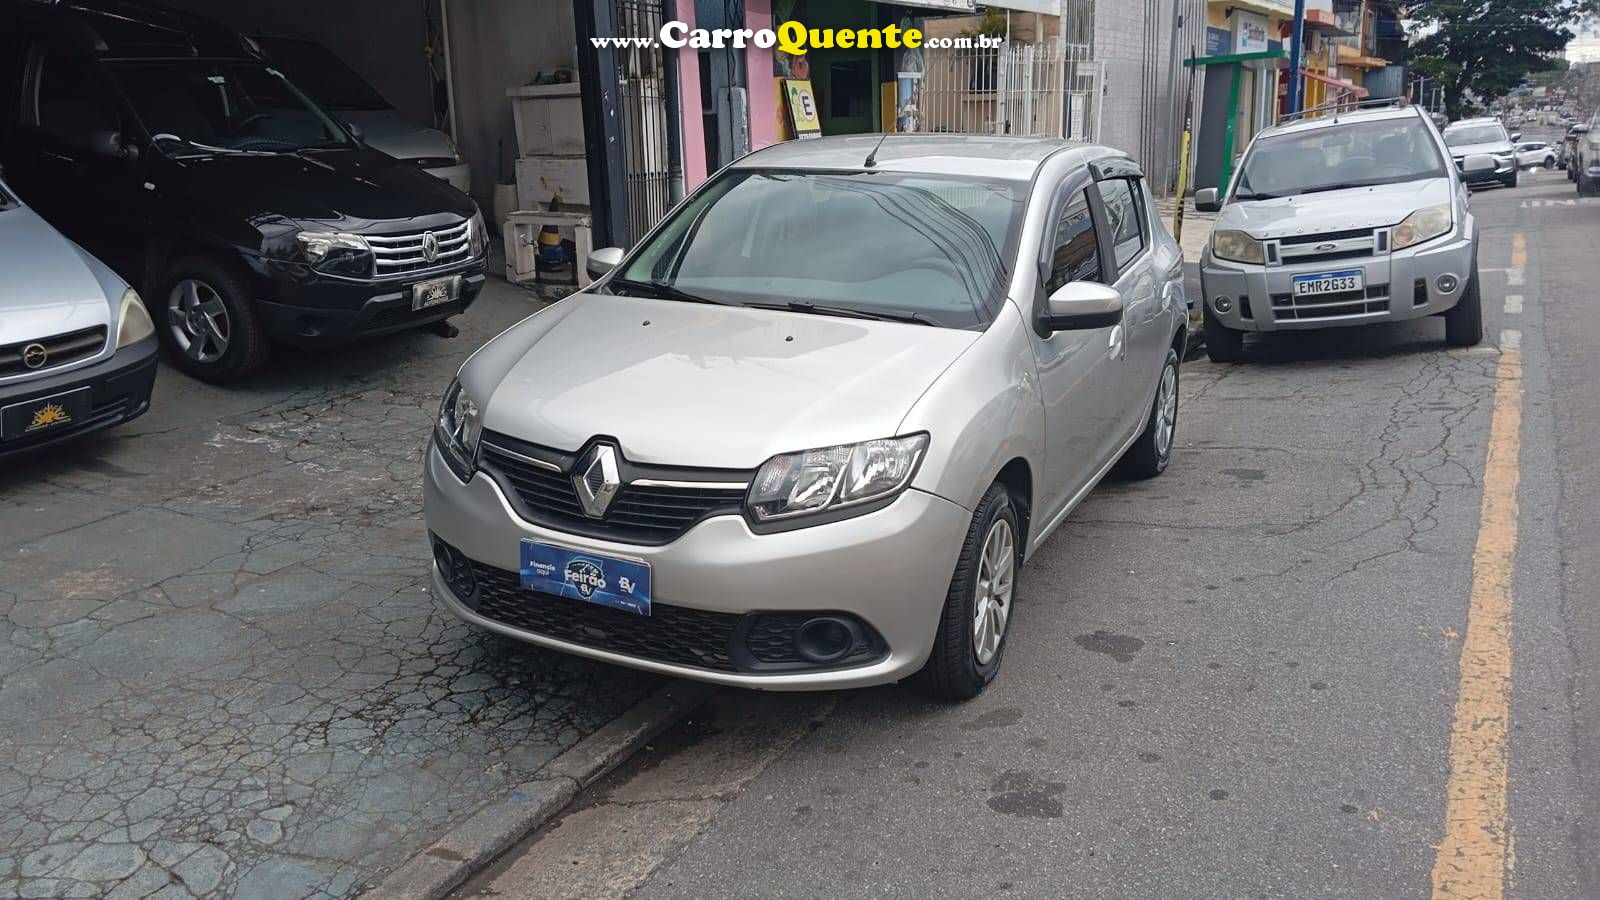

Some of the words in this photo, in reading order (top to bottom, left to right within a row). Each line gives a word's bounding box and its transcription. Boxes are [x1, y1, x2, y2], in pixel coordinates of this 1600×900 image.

[801, 95, 813, 116] E
[1299, 277, 1356, 294] EMR2G33
[564, 569, 607, 588] Feirão
[618, 576, 637, 594] BV
